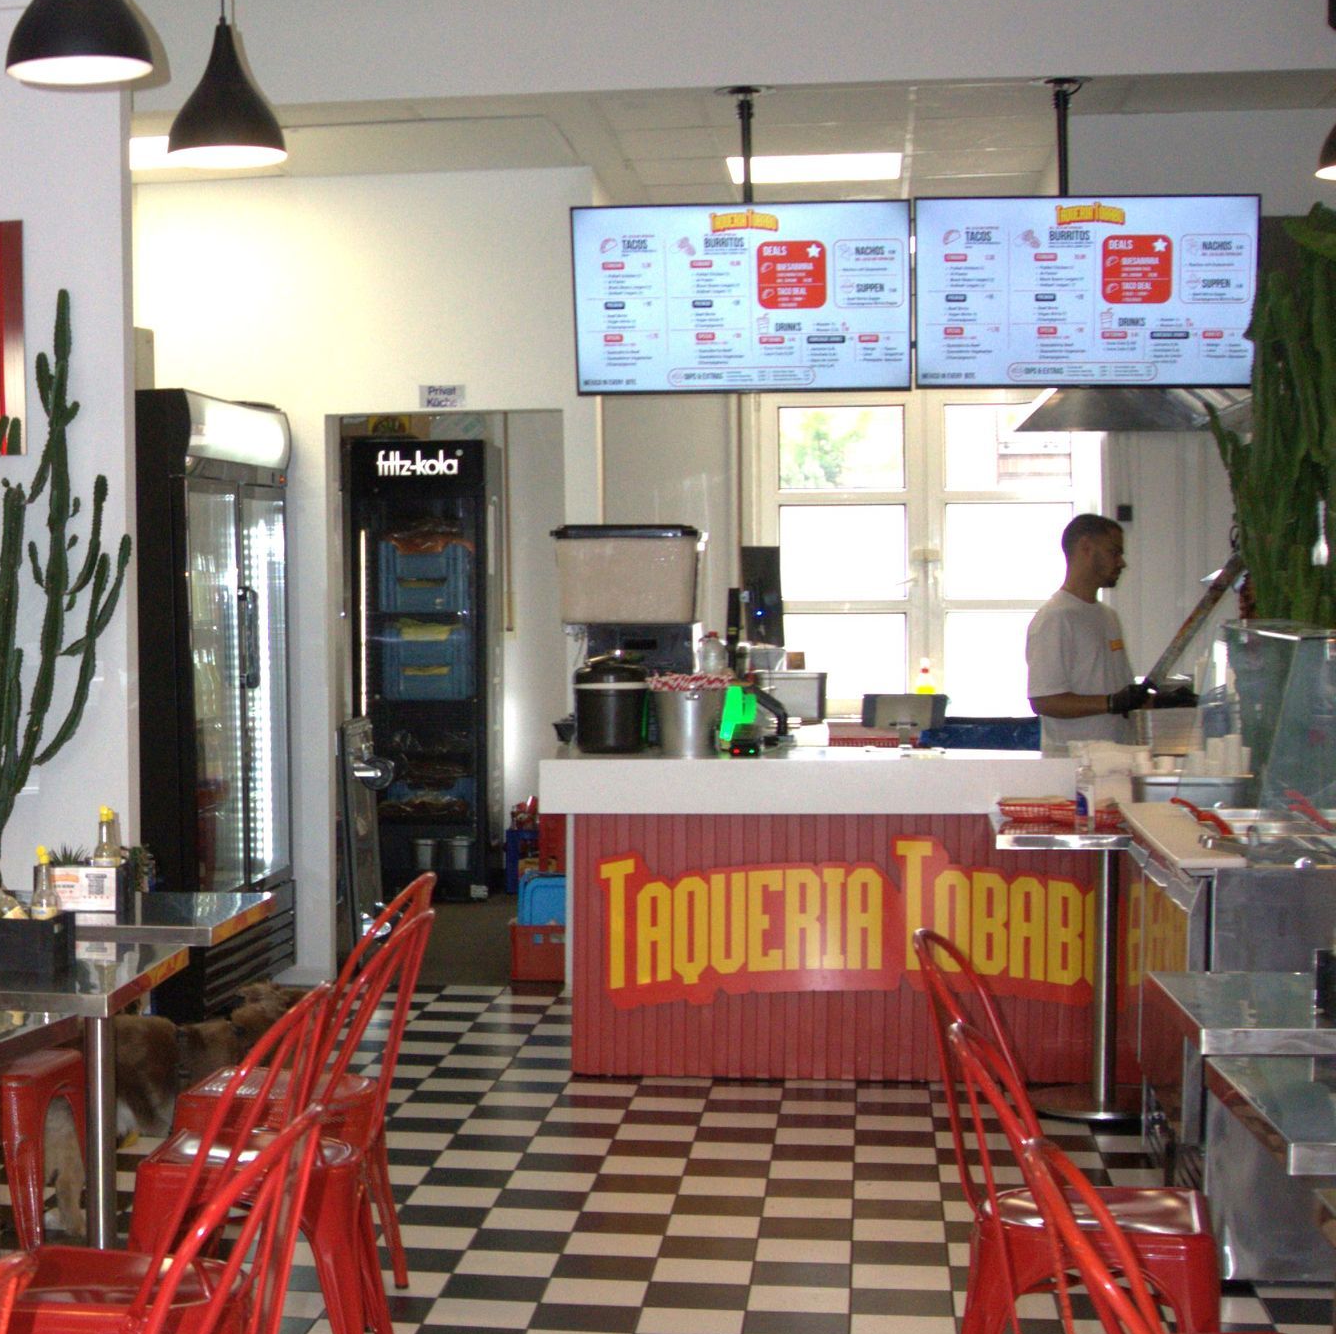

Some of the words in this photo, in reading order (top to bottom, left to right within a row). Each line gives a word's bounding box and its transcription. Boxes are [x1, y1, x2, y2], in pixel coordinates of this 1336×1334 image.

[965, 231, 992, 242] TACOS
[1049, 229, 1090, 241] BURRITOS
[621, 239, 648, 250] TACOS
[704, 237, 745, 248] BURRITOS
[1108, 240, 1133, 250] DEALS
[1202, 240, 1232, 250] NACHOS
[762, 245, 787, 256] DEALS
[855, 245, 885, 255] NACHOS
[1201, 278, 1231, 288] SUPPEN
[376, 449, 459, 476] fritz-kola
[599, 857, 884, 991] TAQUERIA
